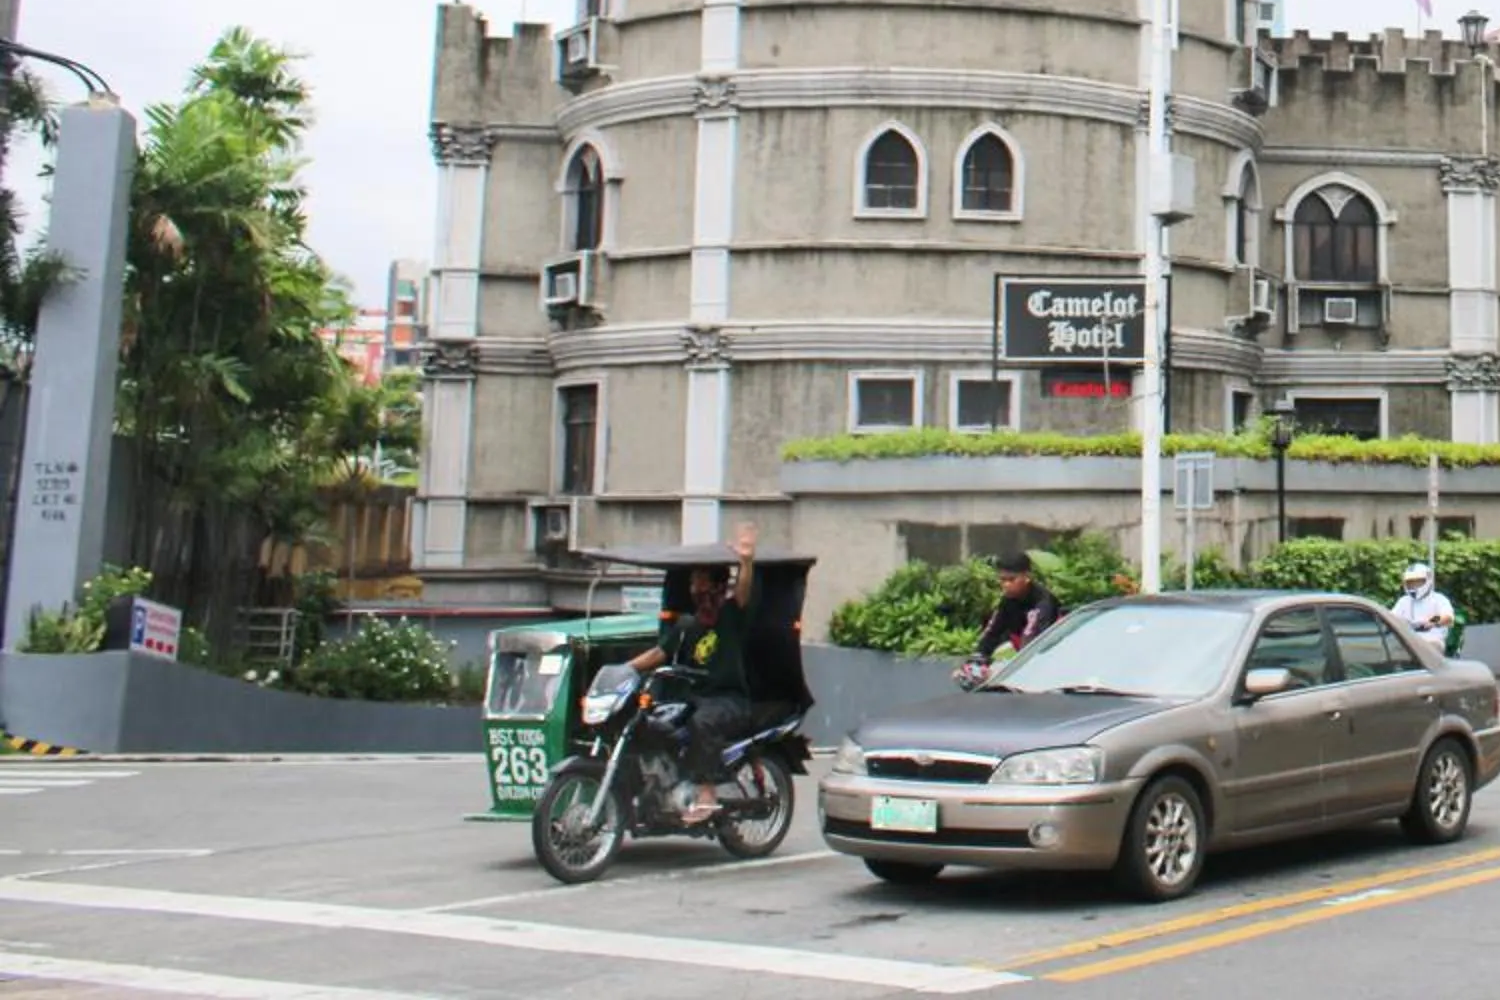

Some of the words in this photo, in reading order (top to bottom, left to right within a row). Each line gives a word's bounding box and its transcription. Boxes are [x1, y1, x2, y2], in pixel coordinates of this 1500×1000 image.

[1027, 289, 1139, 318] Camelot
[1048, 320, 1125, 353] Hotel
[492, 746, 549, 784] 263
